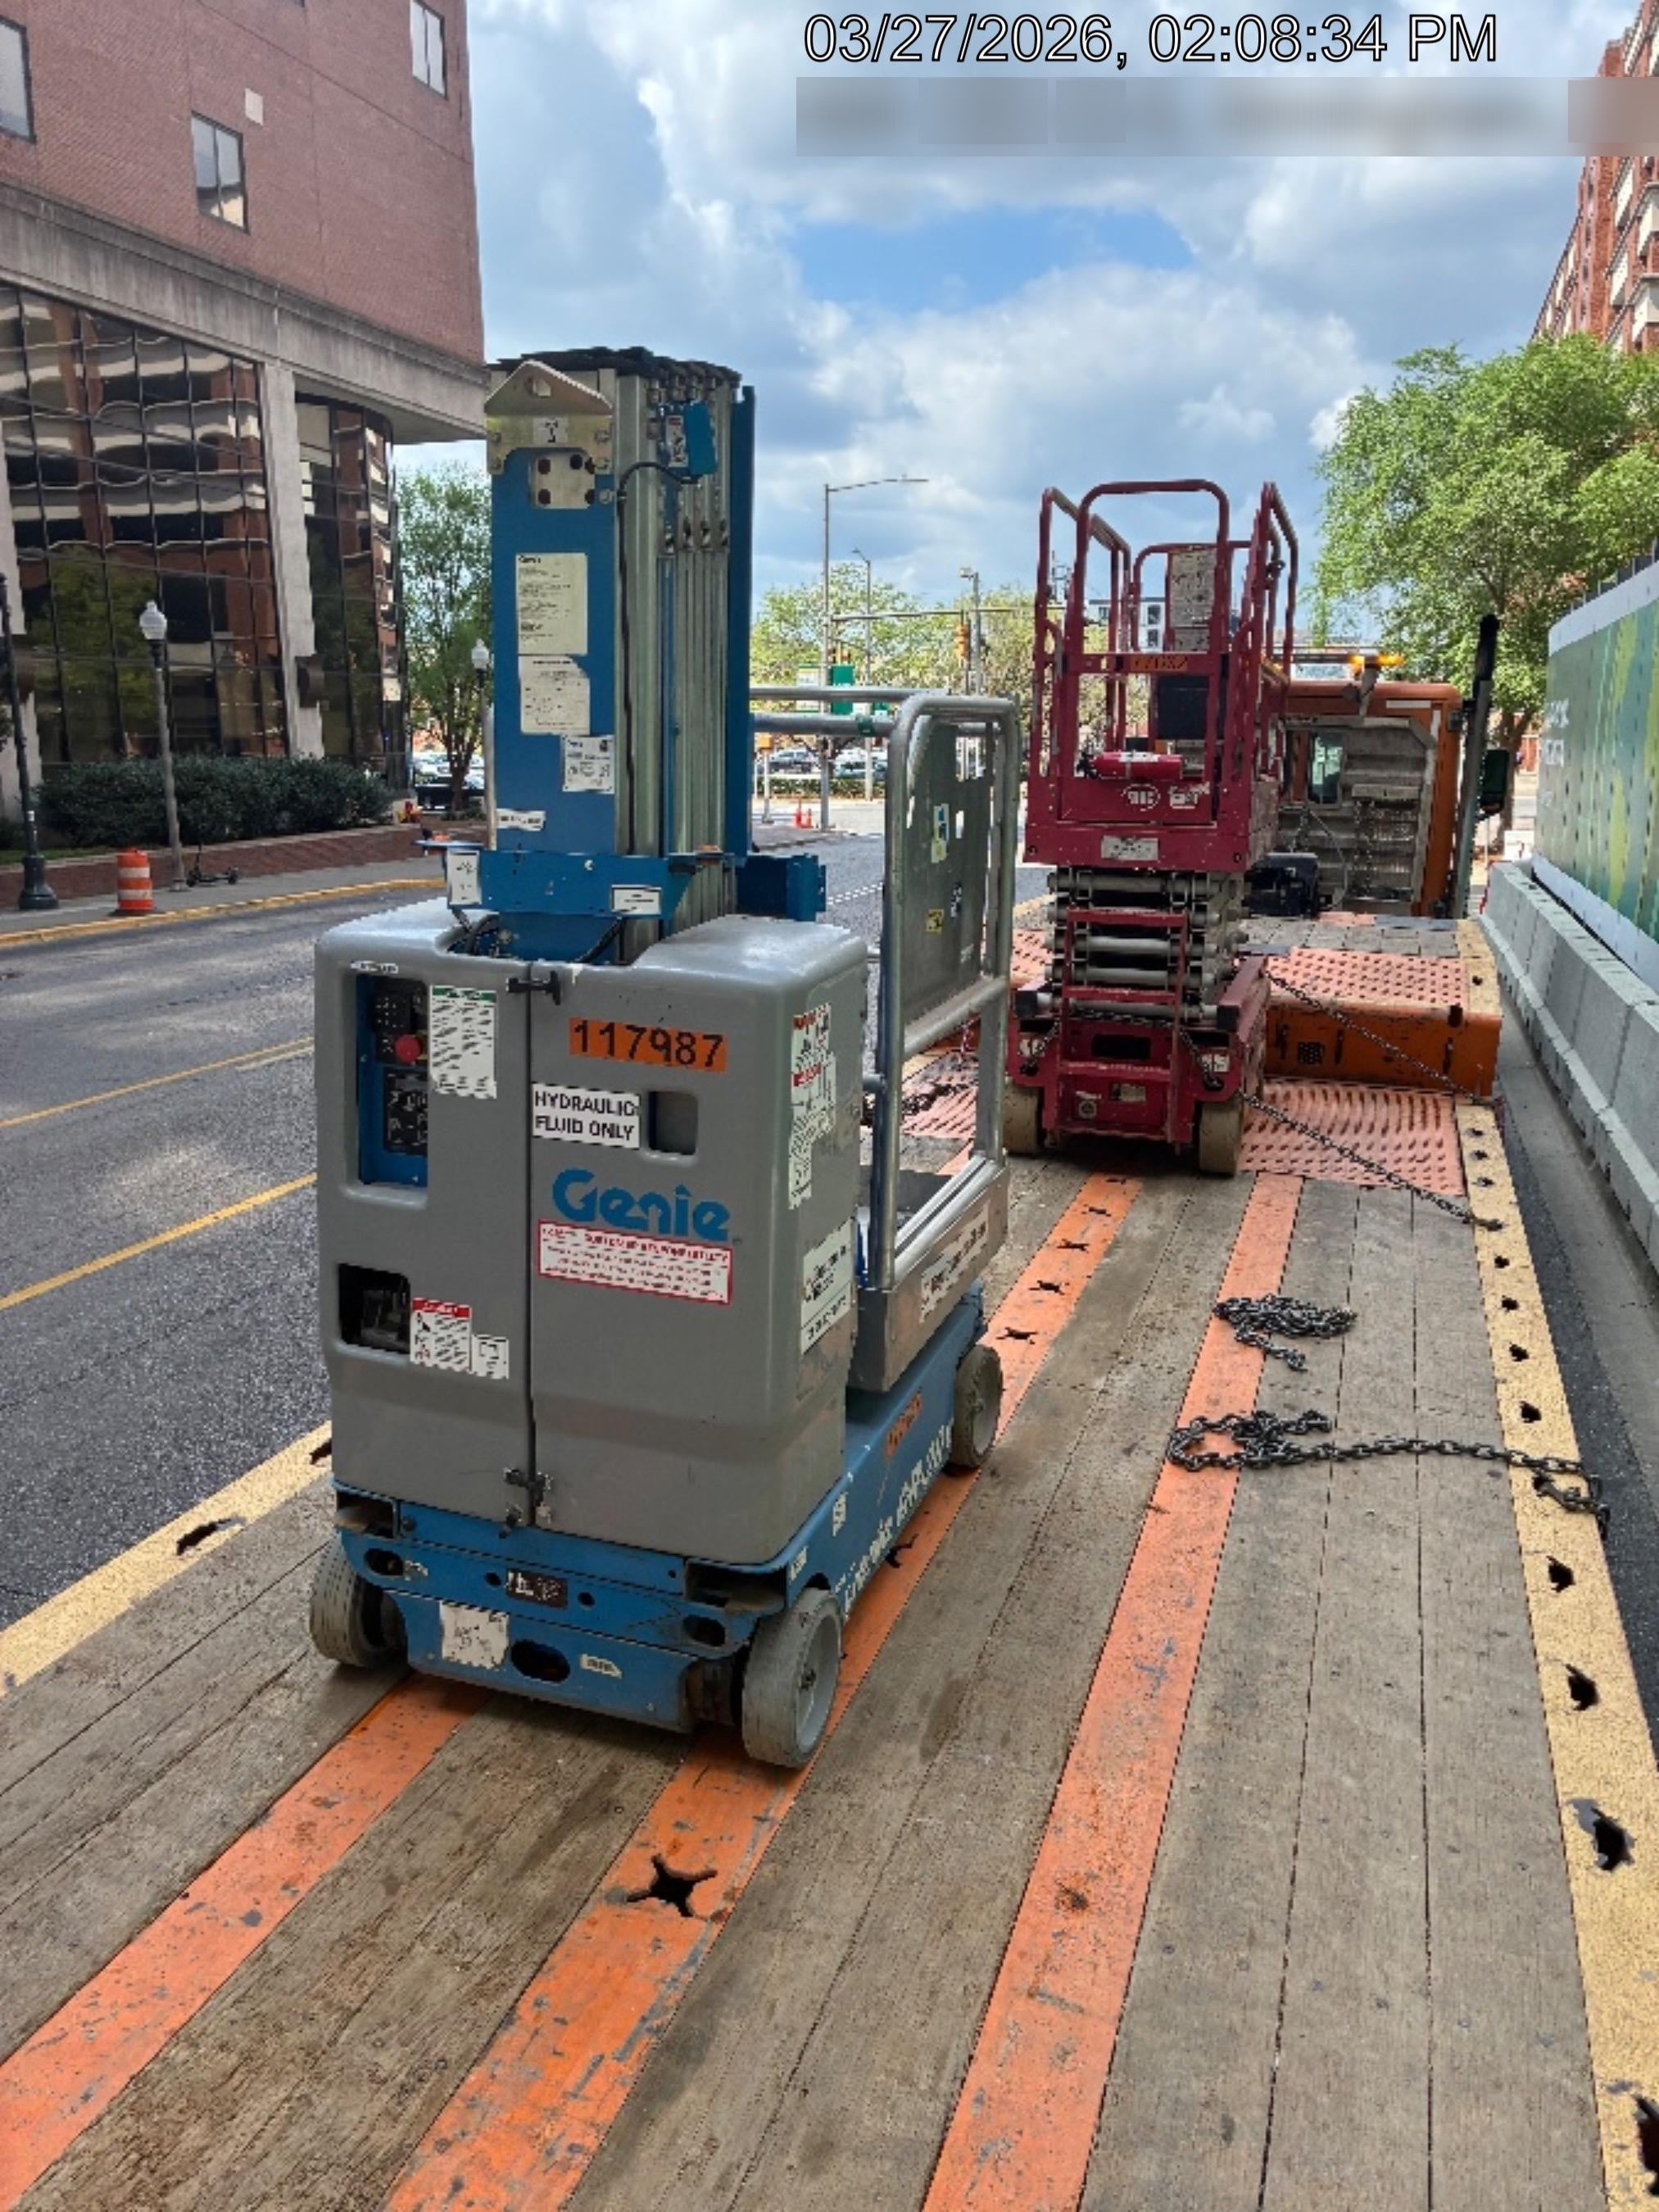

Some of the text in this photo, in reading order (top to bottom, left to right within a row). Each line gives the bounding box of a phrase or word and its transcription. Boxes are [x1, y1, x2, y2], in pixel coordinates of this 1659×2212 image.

[574, 1019, 724, 1067] 117987
[534, 1090, 637, 1117] HYDRAULIC
[535, 1116, 635, 1141] FLUID ONLY
[553, 1168, 730, 1242] Genie
